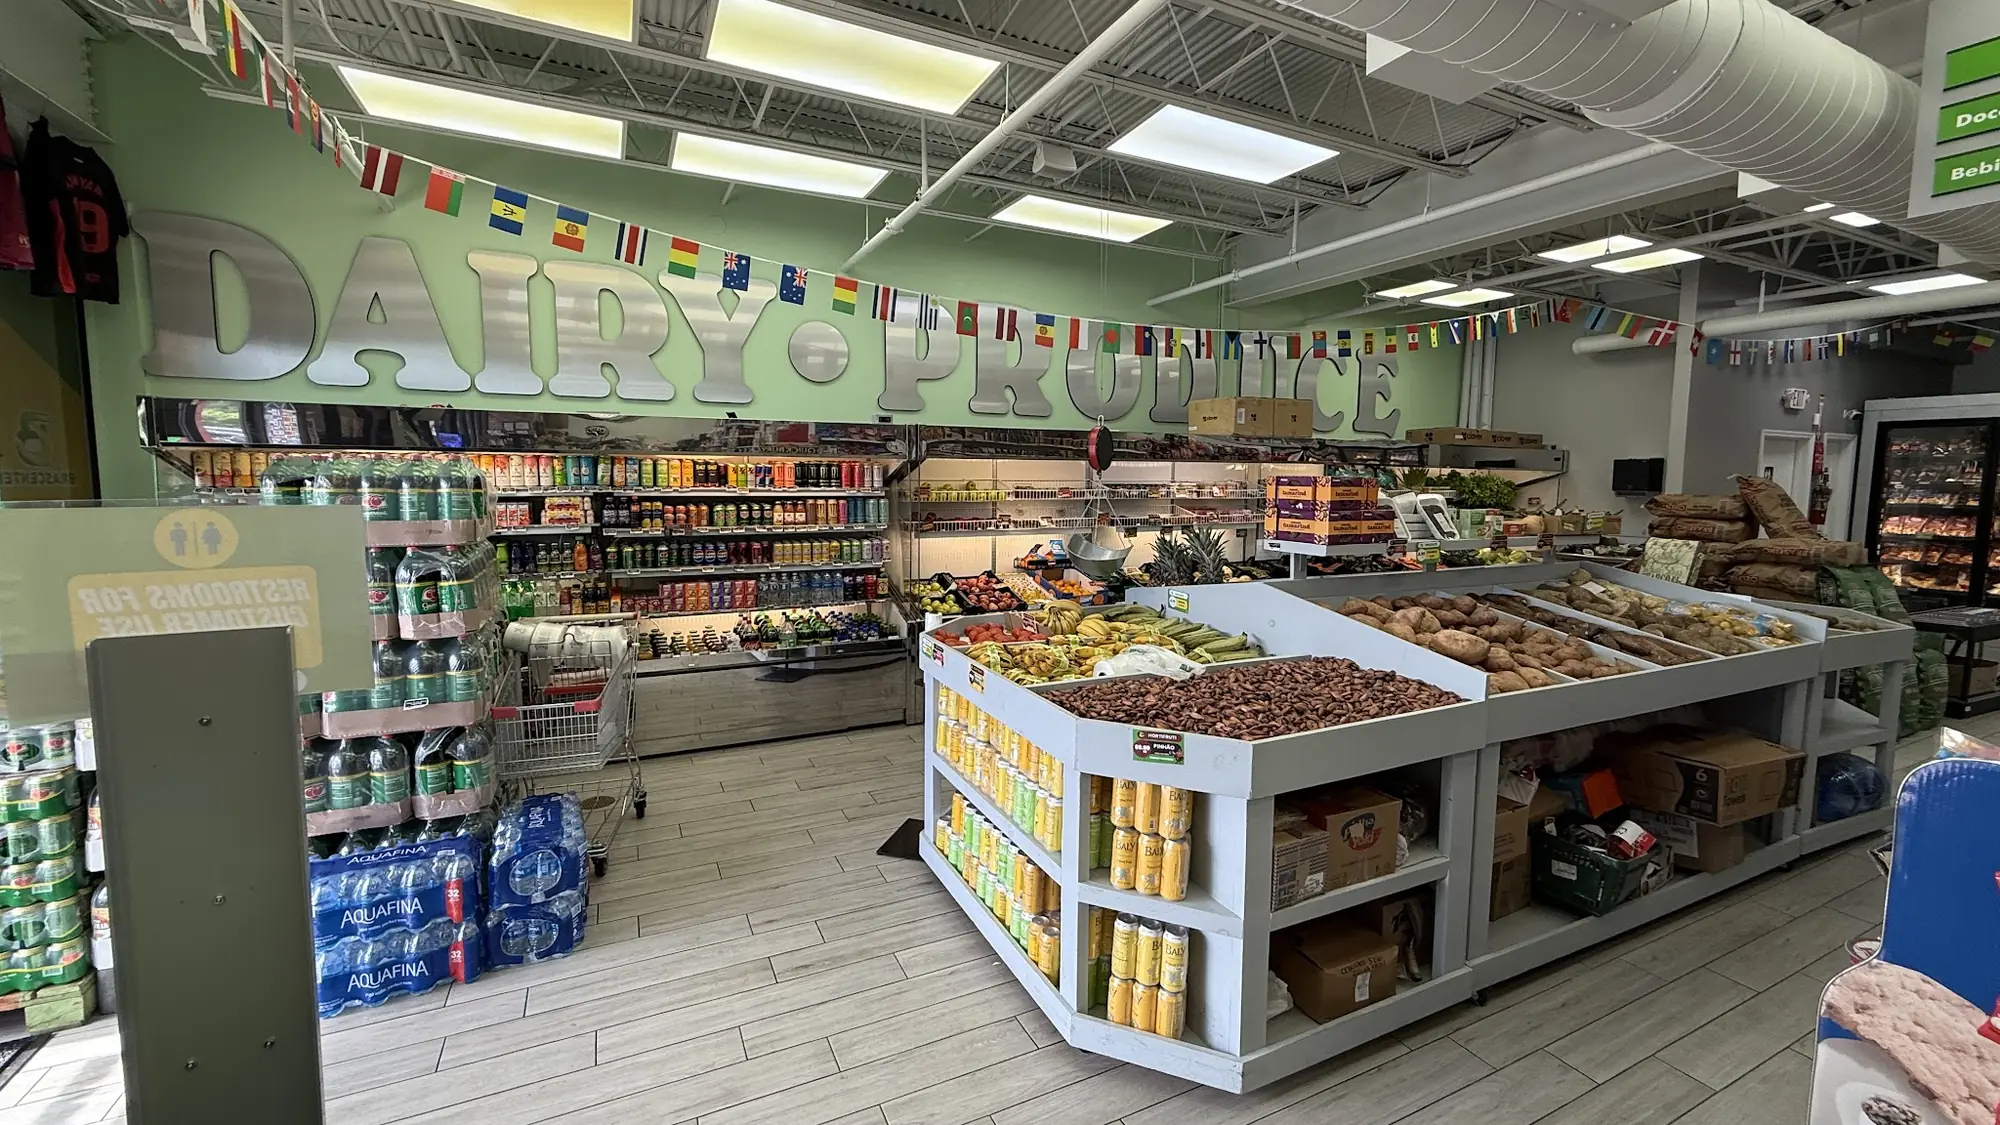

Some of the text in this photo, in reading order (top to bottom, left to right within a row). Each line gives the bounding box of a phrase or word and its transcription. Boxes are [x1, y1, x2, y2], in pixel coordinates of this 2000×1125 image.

[1956, 109, 2000, 128] Doc
[130, 211, 1402, 438] DAIRY PRODUCE
[1153, 743, 1176, 751] PINHÃO
[1695, 768, 1708, 782] 6
[346, 845, 427, 865] AQUAFINA
[1115, 839, 1136, 852] BALY
[340, 889, 460, 929] AQUAFINA 32
[1165, 943, 1186, 957] BALY
[347, 950, 462, 993] AQUAFINA 32
